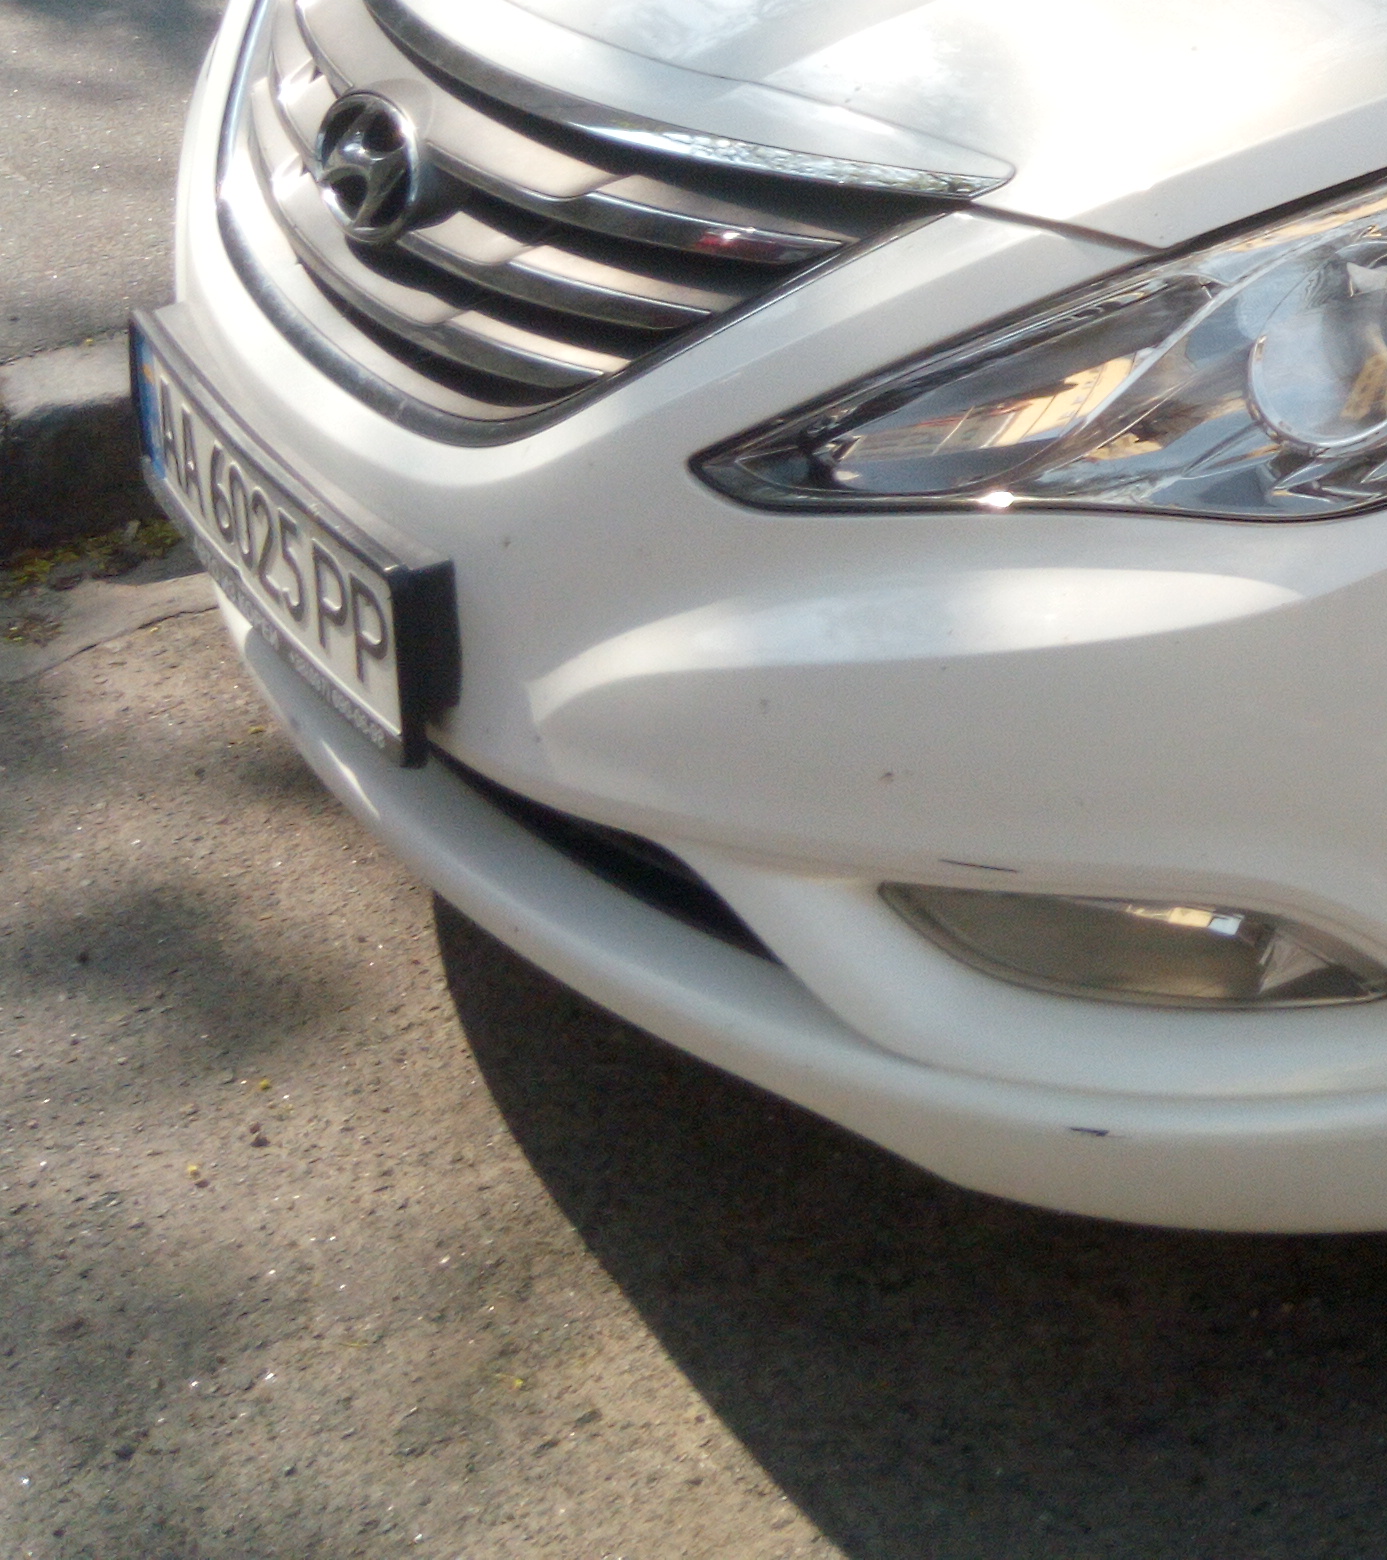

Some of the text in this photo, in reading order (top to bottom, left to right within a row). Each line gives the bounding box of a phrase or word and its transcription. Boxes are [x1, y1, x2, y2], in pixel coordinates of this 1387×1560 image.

[160, 375, 206, 515] AA
[210, 440, 306, 622] 6025
[312, 538, 388, 683] PP
